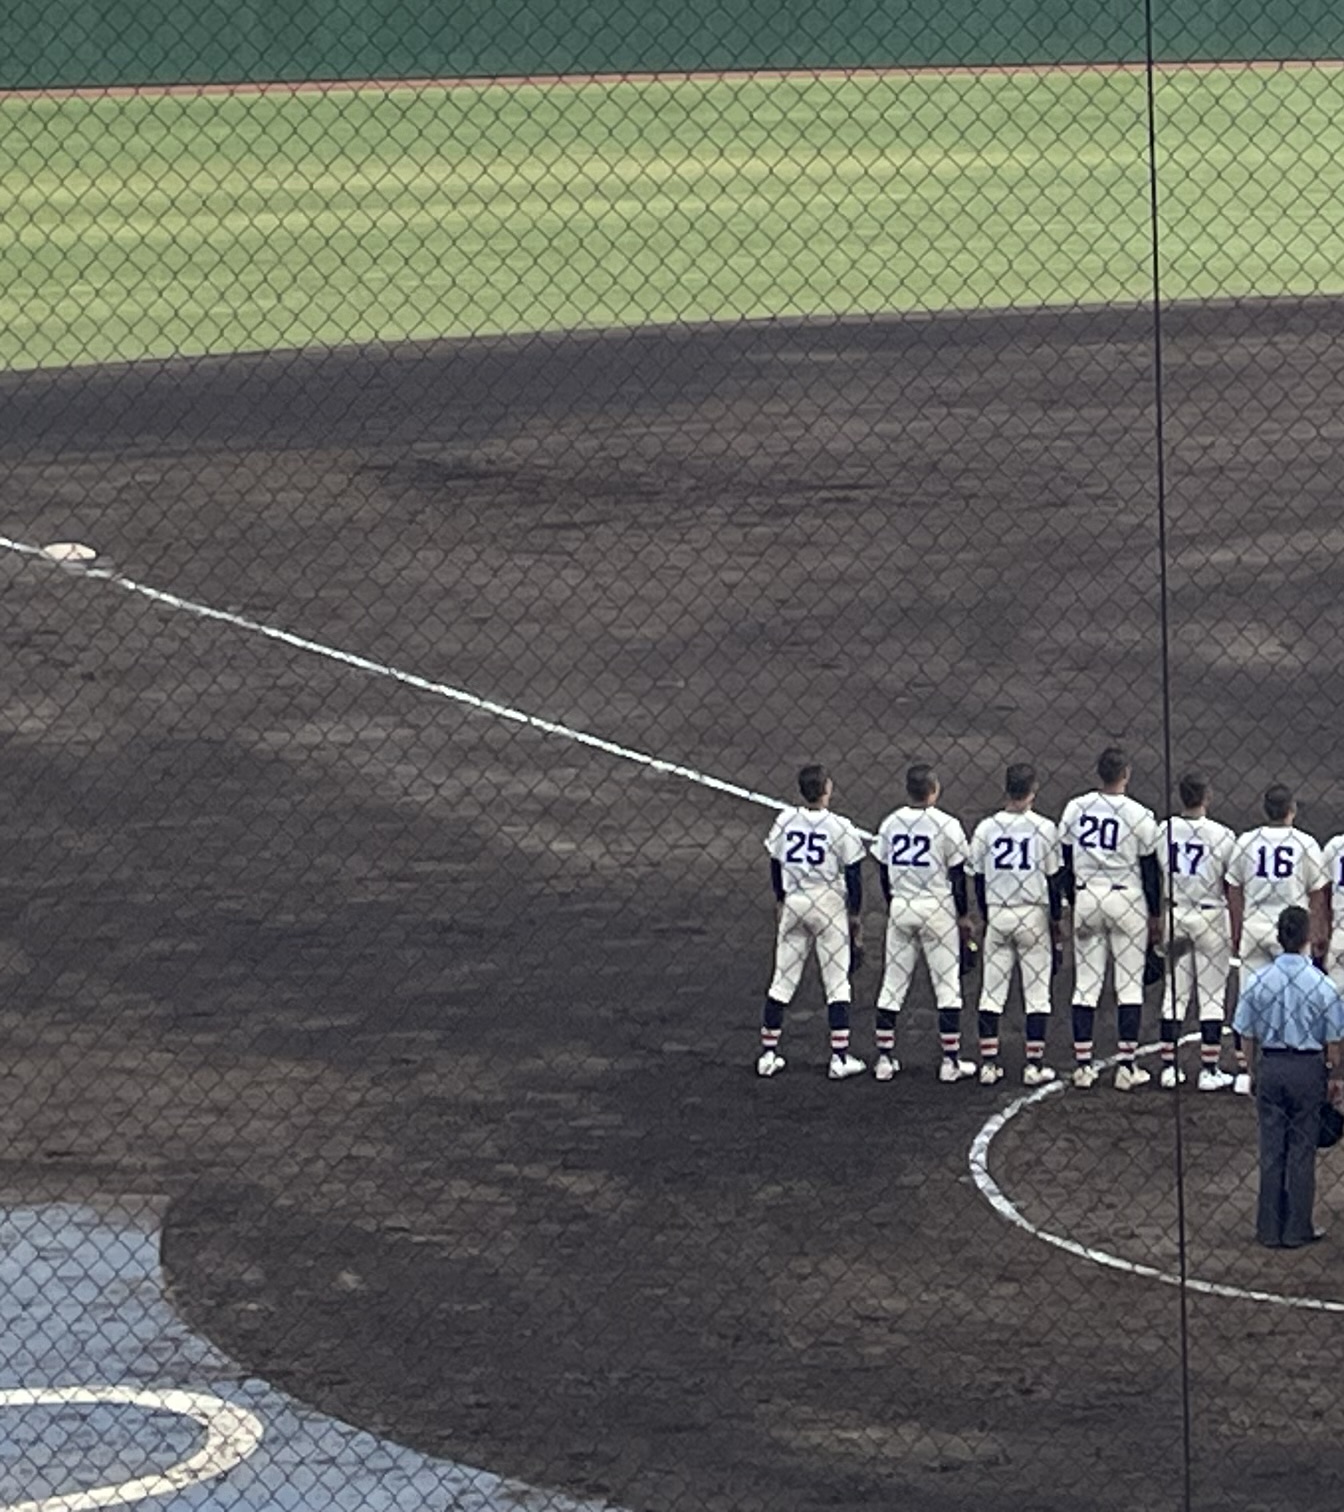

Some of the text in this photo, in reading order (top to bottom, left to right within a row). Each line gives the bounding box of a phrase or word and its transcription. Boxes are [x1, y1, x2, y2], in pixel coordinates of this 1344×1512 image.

[786, 831, 827, 865] 25
[1080, 815, 1119, 851] 20
[892, 834, 931, 867] 22
[994, 837, 1032, 870] 21
[1170, 842, 1206, 875] 17
[1255, 846, 1295, 878] 16
